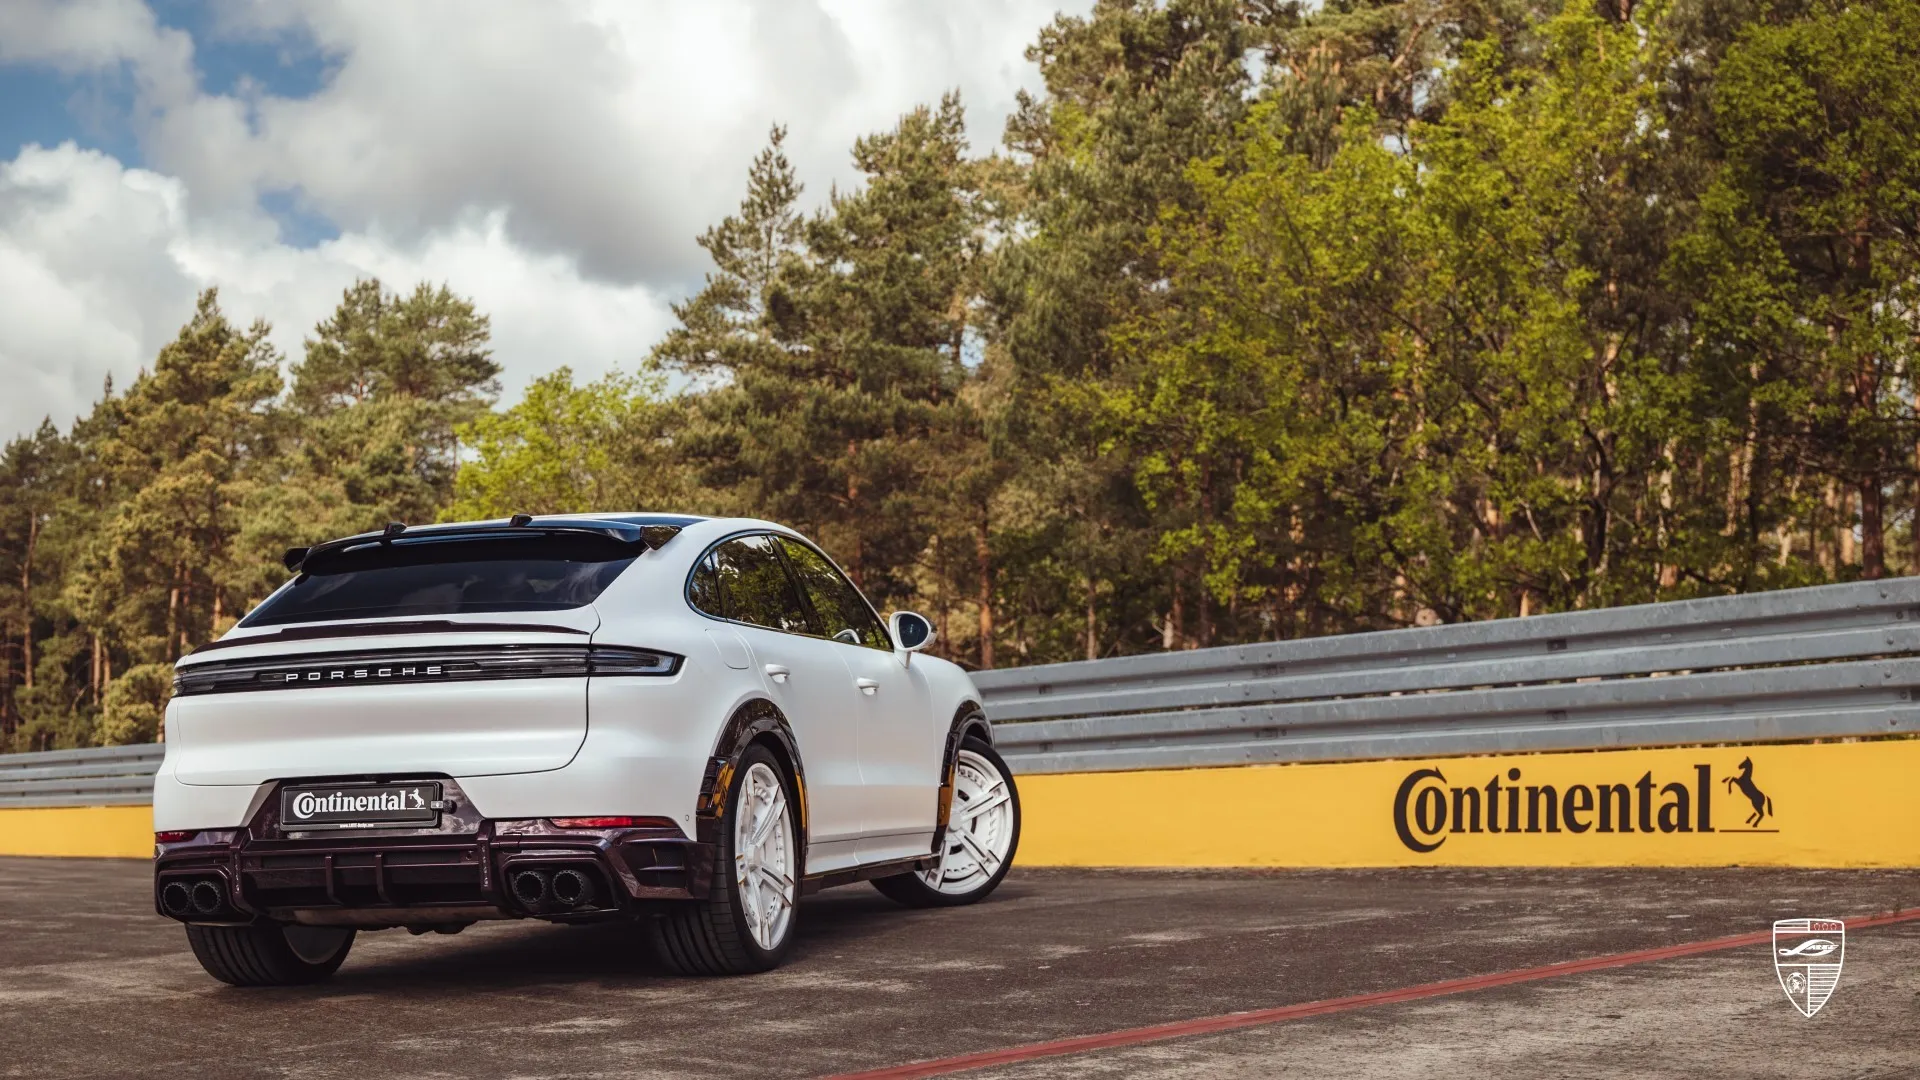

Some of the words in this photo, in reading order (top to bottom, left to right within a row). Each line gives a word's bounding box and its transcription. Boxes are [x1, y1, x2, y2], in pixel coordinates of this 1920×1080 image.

[286, 666, 442, 682] PORSCHE
[293, 790, 407, 819] Continental
[1393, 764, 1715, 853] Continental
